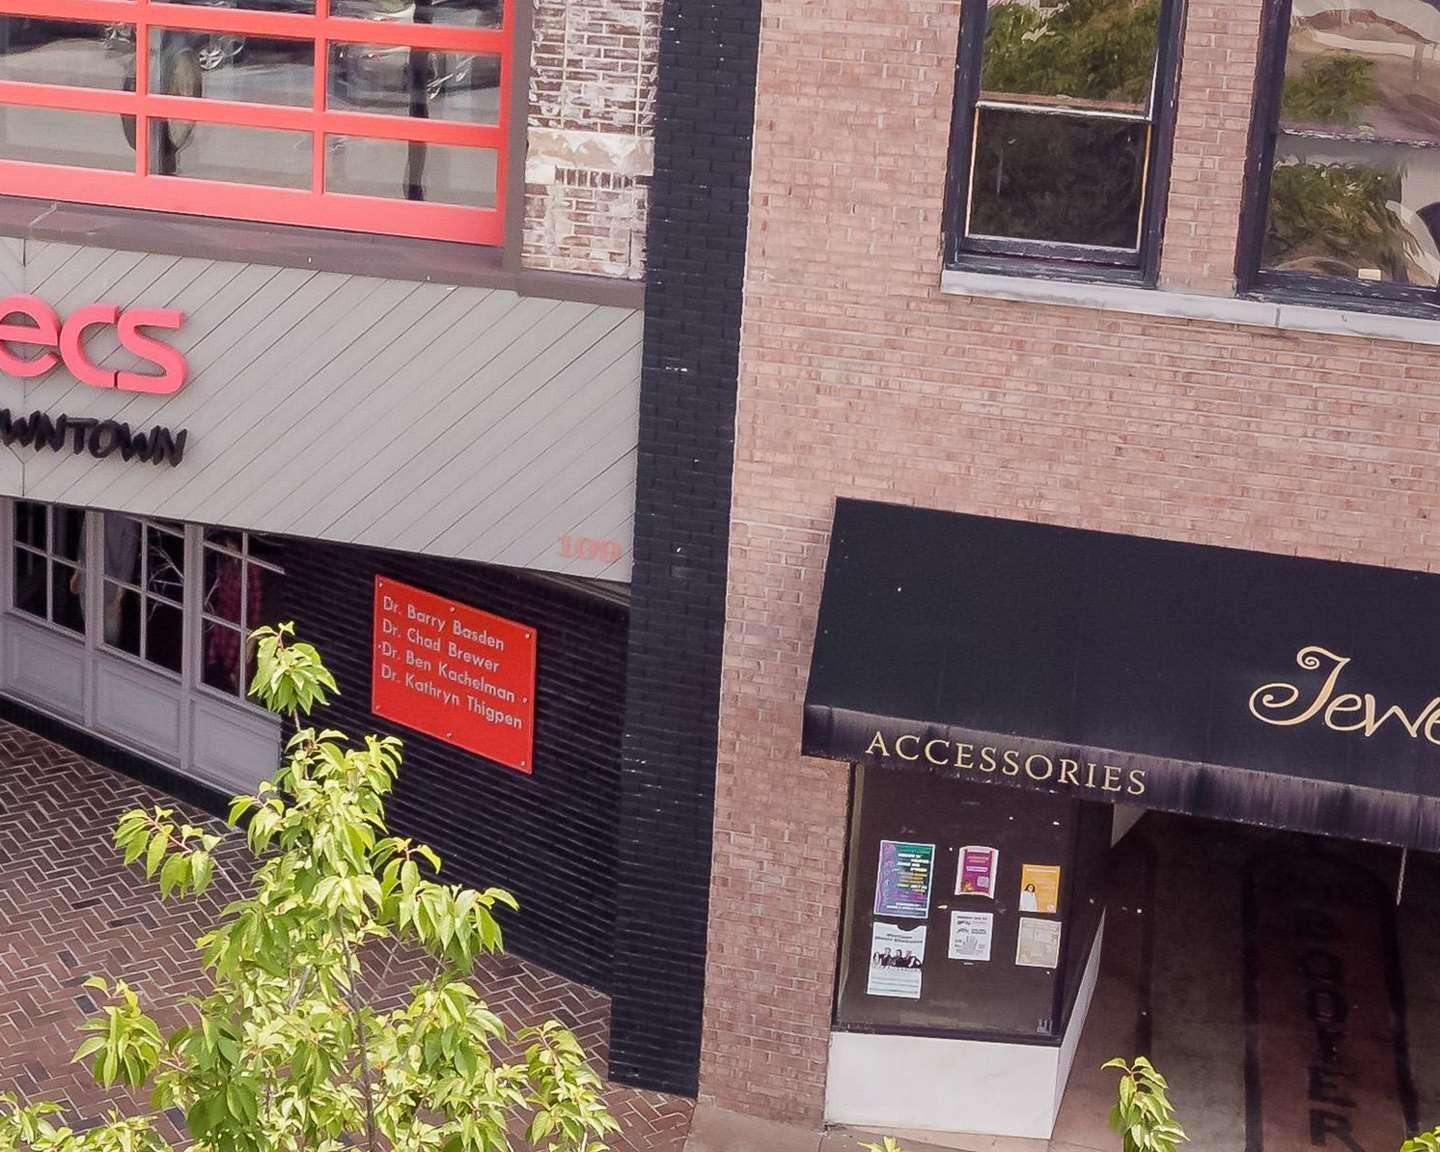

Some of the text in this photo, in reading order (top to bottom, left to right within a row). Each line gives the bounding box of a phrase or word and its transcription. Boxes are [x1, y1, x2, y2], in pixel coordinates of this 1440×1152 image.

[382, 618, 500, 673] Dr. Chad Brewer
[383, 596, 504, 651] Dr. Barry Basden
[381, 664, 522, 730] Dr. Kathryn Thigpen
[382, 641, 515, 703] Dr. Ben Kachelman
[865, 730, 1147, 795] ACCESSORIES
